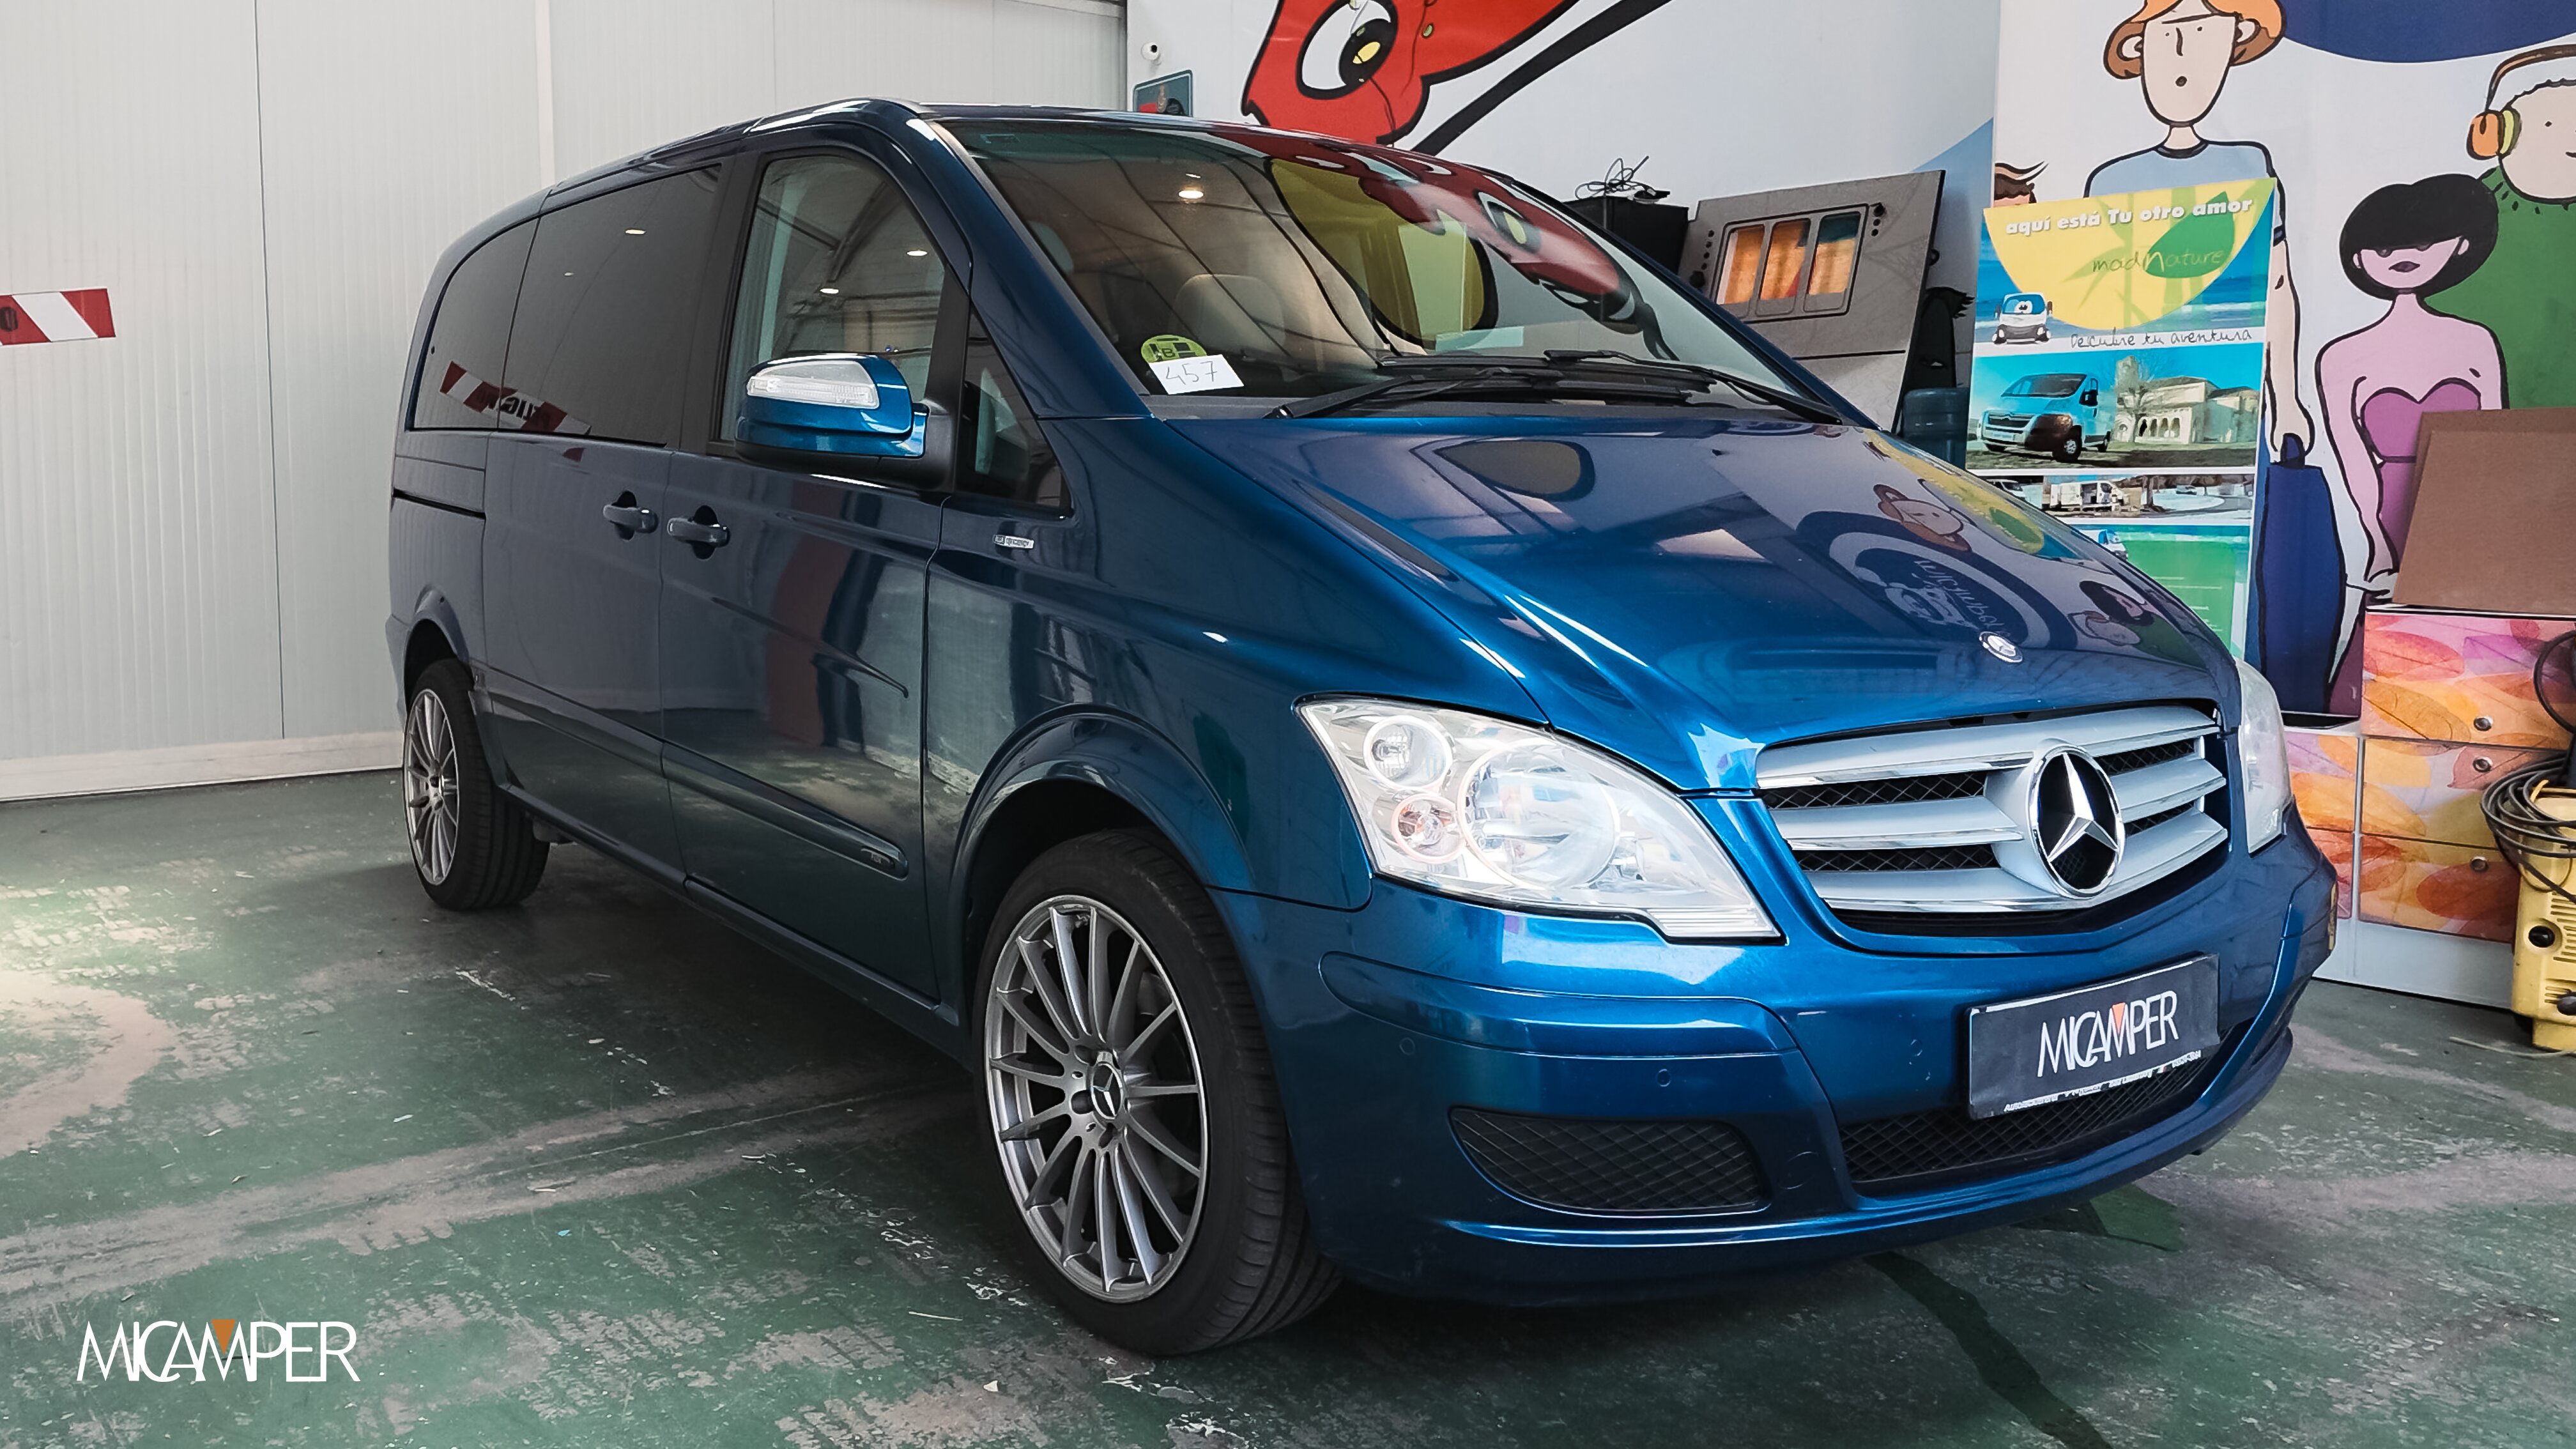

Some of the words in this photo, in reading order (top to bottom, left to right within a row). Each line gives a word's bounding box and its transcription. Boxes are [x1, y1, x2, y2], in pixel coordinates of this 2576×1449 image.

[2006, 216, 2051, 236] aquí
[2057, 211, 2101, 230] está
[2108, 208, 2133, 226] Tu
[2140, 206, 2185, 222] otro
[2192, 198, 2253, 217] amor
[2142, 332, 2165, 345] tu
[2171, 328, 2252, 344] aventura
[1162, 348, 1176, 358] B
[1165, 360, 1218, 385] 457
[2037, 990, 2179, 1077] MICAMPER
